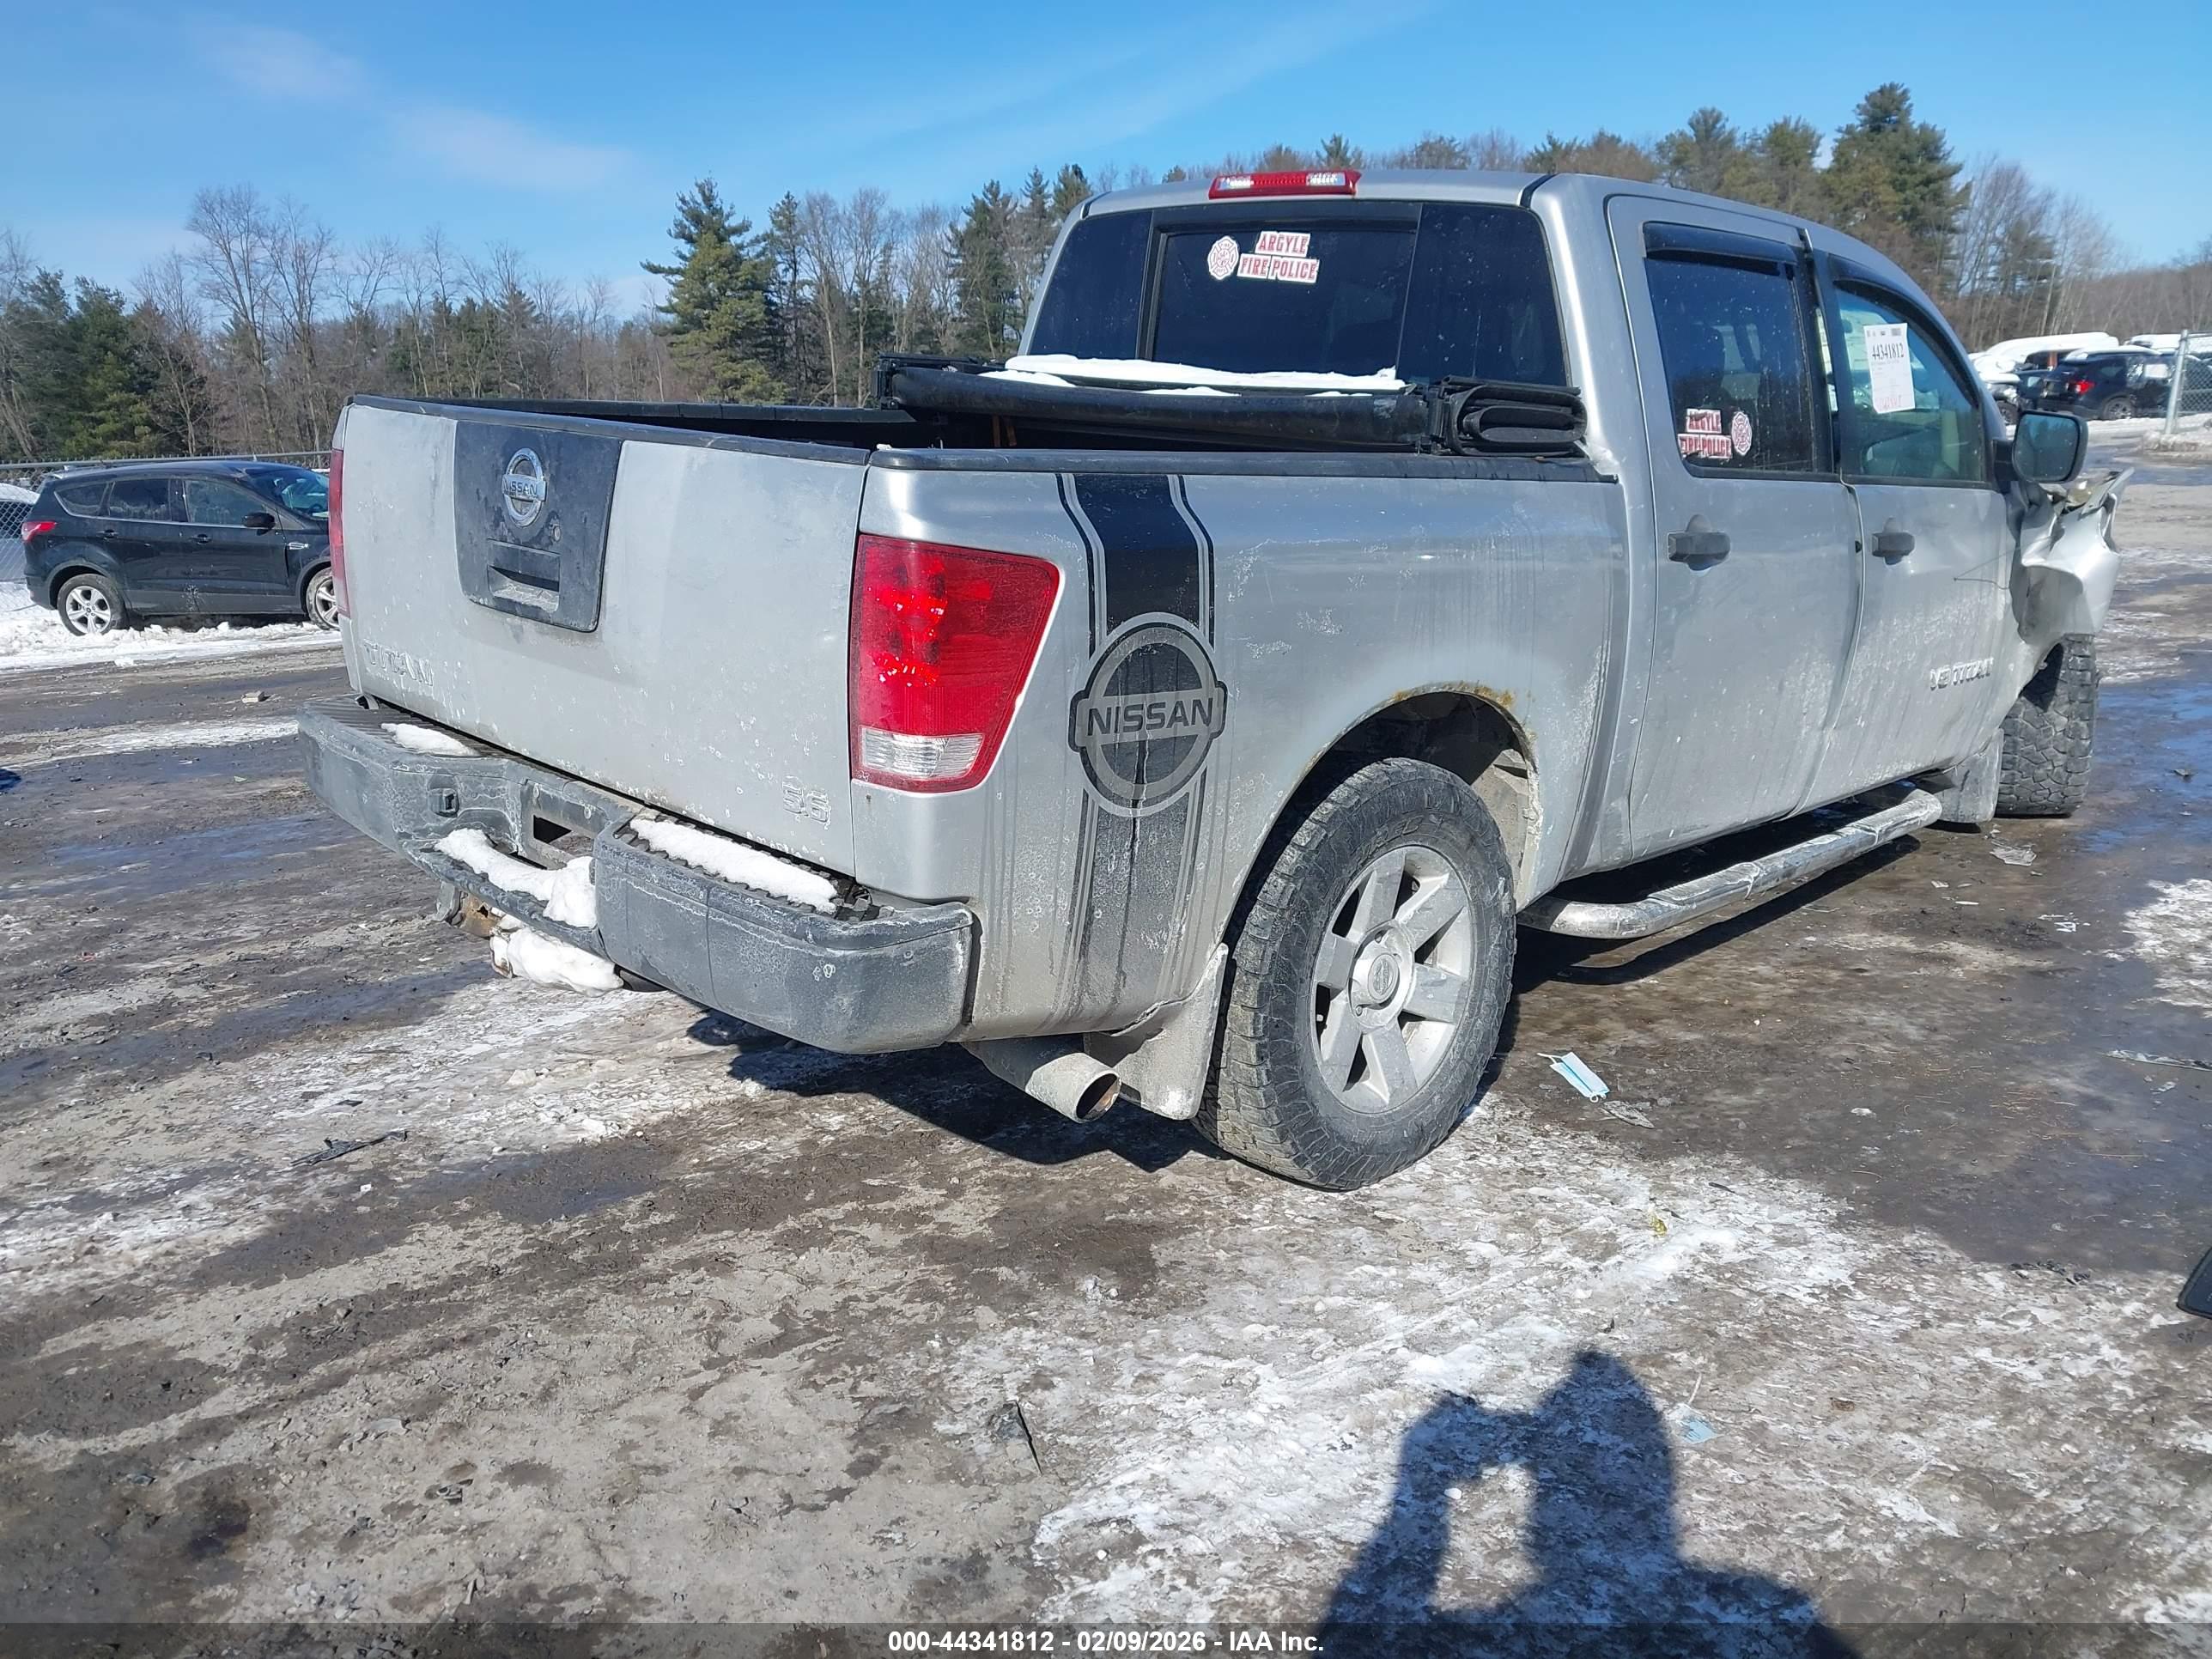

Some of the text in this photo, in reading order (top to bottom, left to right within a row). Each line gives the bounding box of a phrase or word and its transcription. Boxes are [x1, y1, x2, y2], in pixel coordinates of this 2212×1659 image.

[1258, 233, 1309, 254] ARGYLE
[1239, 257, 1318, 280] FIRE POLICE
[1872, 343, 1905, 361] 44341812
[1702, 437, 1732, 457] POLICE
[503, 479, 538, 496] NISSAN
[1087, 697, 1213, 737] NISSAN
